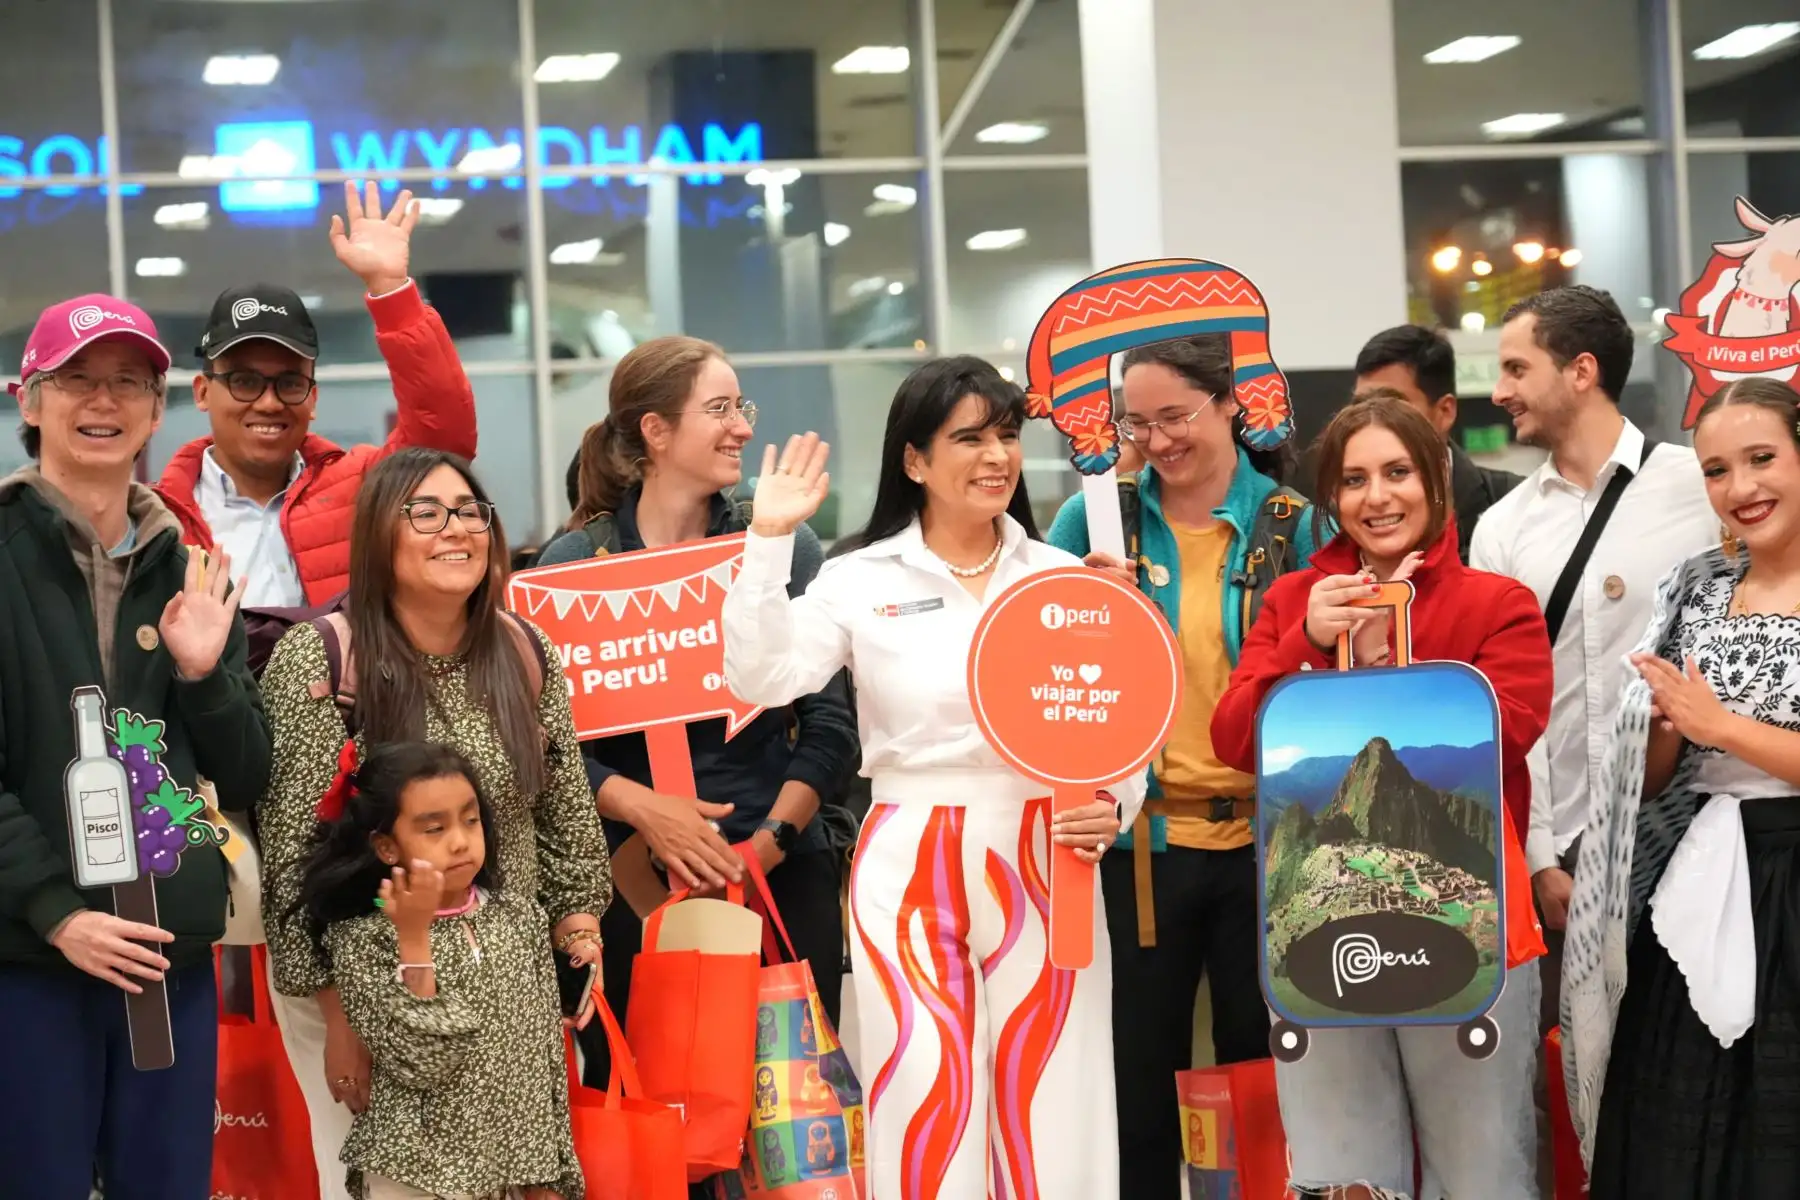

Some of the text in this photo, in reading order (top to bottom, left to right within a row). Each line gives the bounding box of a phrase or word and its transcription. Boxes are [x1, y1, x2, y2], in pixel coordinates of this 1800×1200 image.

[330, 121, 764, 192] WYNDHAM
[1707, 345, 1747, 362] ¡Viva
[1750, 347, 1765, 362] el
[599, 619, 718, 662] arrived
[582, 657, 669, 695] Peru!
[1050, 664, 1075, 682] Yo
[1030, 683, 1122, 706] viajar por
[1043, 704, 1108, 723] el Perú
[86, 822, 119, 834] Pisco
[1332, 932, 1431, 998] Perú
[214, 1099, 268, 1135] erú
